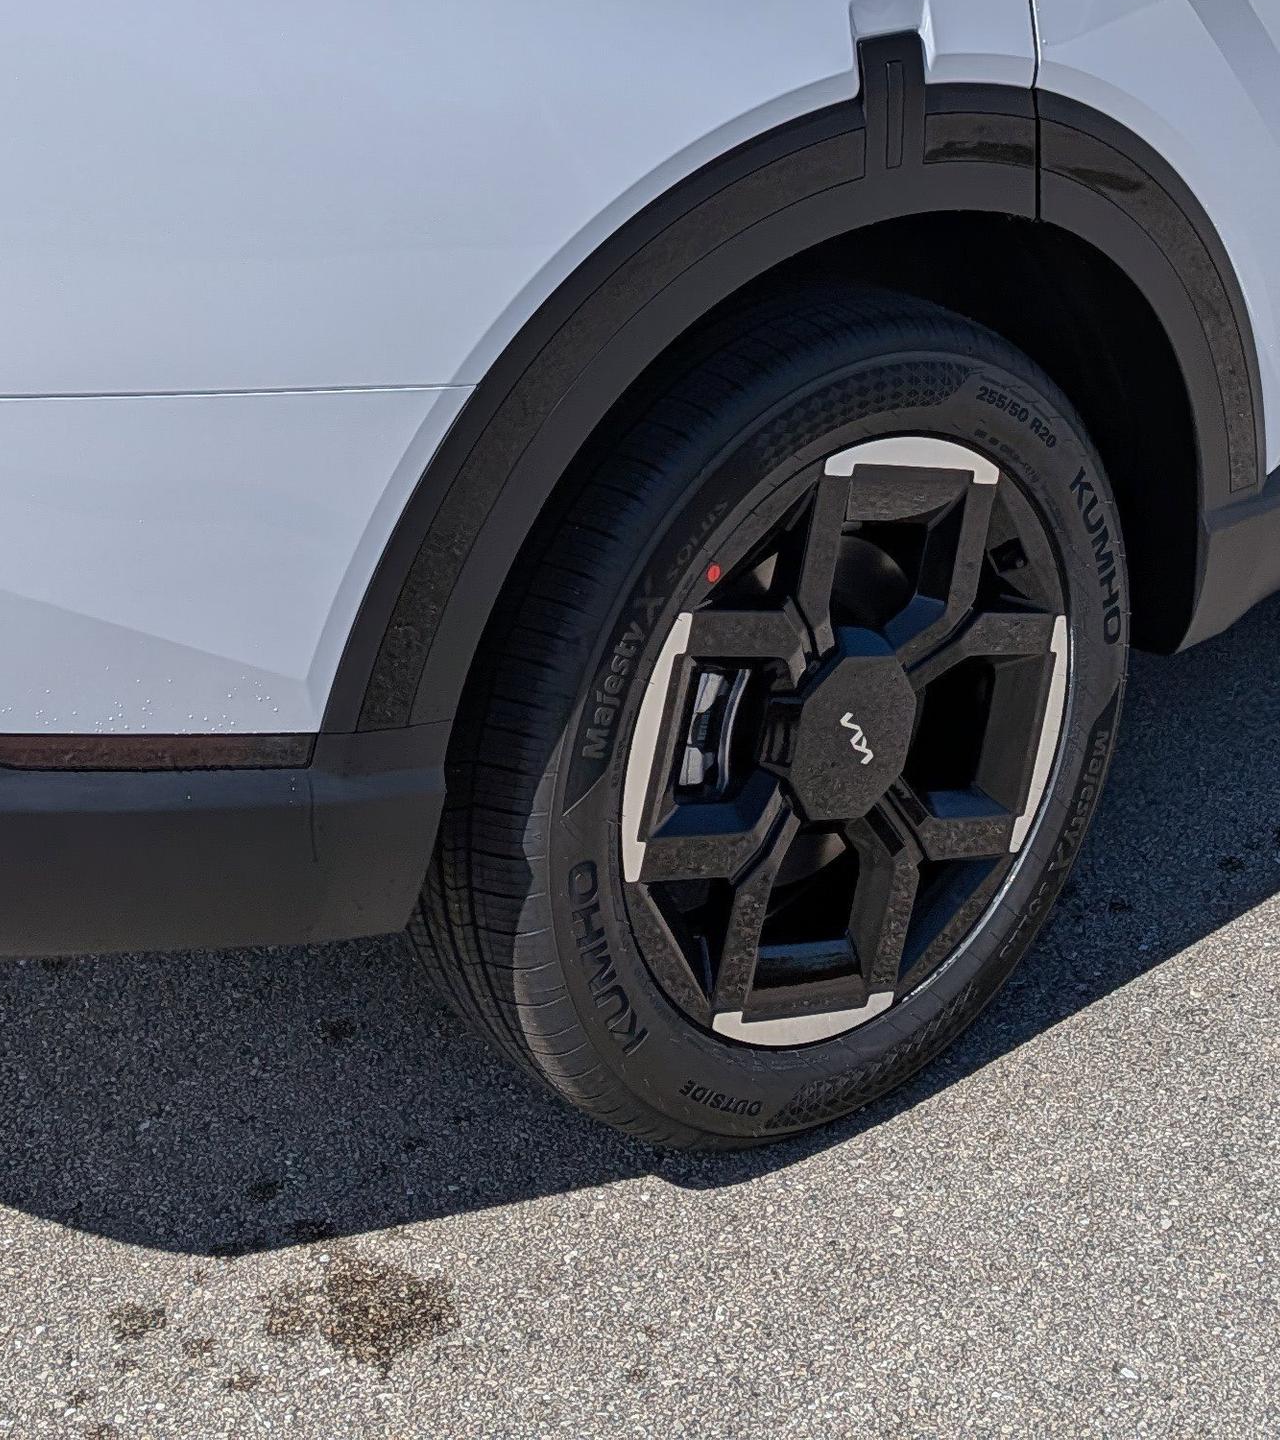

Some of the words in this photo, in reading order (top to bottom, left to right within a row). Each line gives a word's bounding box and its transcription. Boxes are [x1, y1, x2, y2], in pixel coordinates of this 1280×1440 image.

[976, 384, 1030, 423] 255/50
[1029, 417, 1058, 449] R20
[1070, 466, 1121, 645] KUMHO
[582, 620, 646, 759] Majesty
[569, 860, 649, 1057] KUMHO
[679, 1079, 763, 1117] OUTSIDE
